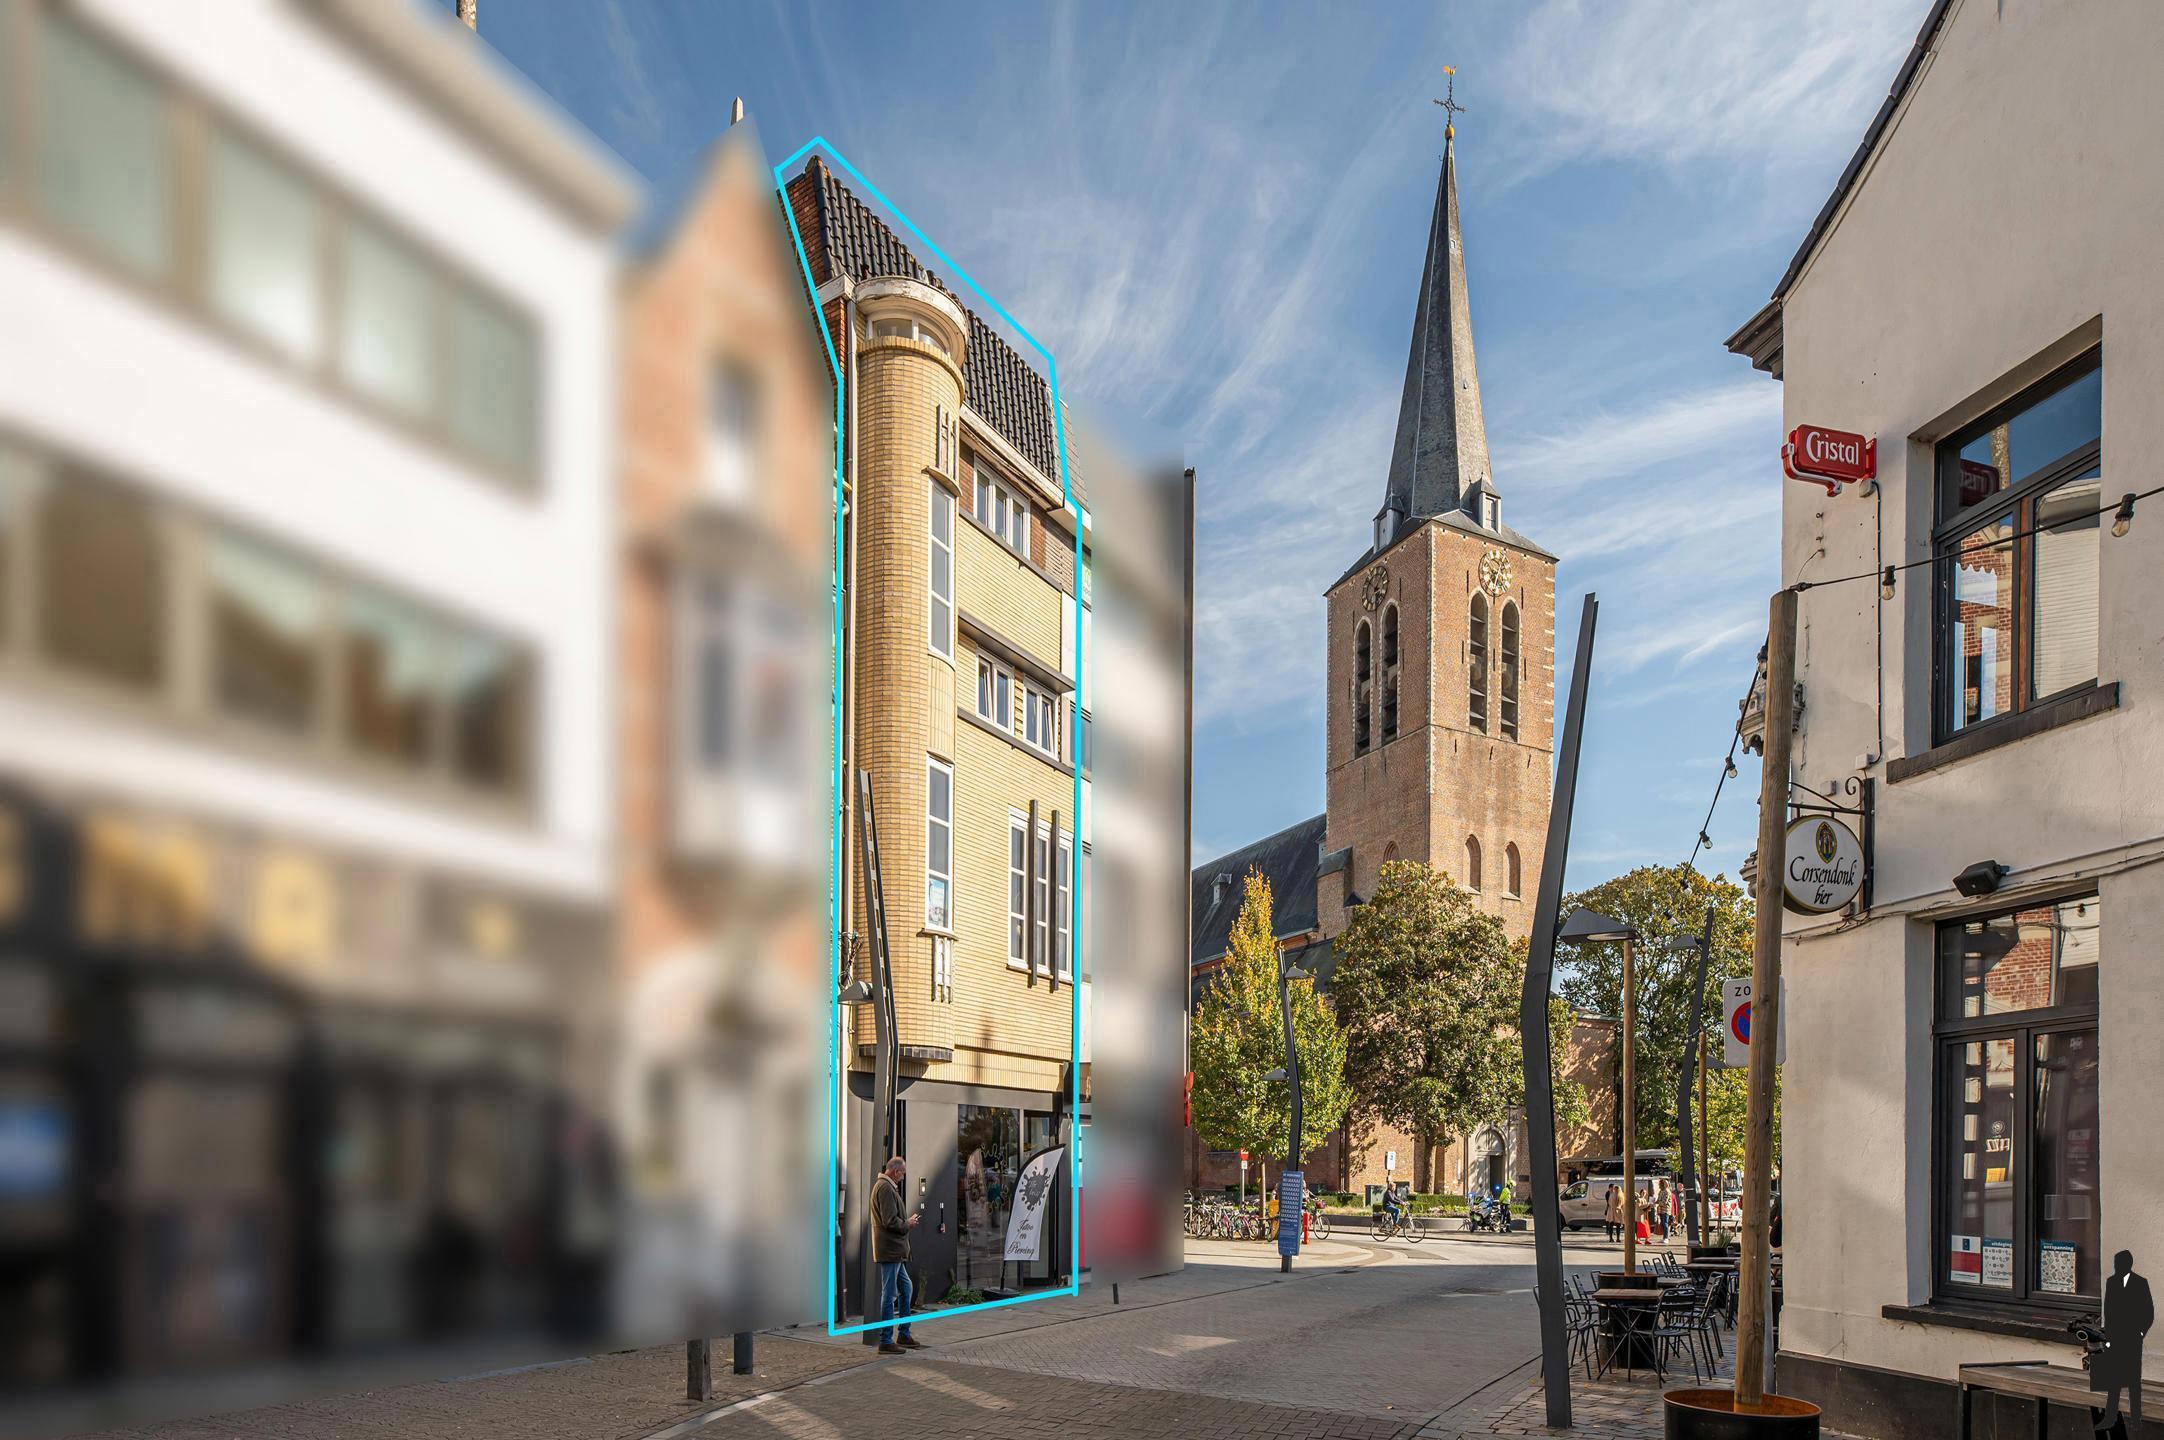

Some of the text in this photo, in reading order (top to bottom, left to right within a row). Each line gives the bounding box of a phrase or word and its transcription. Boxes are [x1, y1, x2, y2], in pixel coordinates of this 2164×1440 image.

[1806, 431, 1860, 465] Cristal
[1790, 856, 1857, 886] Corsendonk
[1813, 884, 1833, 905] bier
